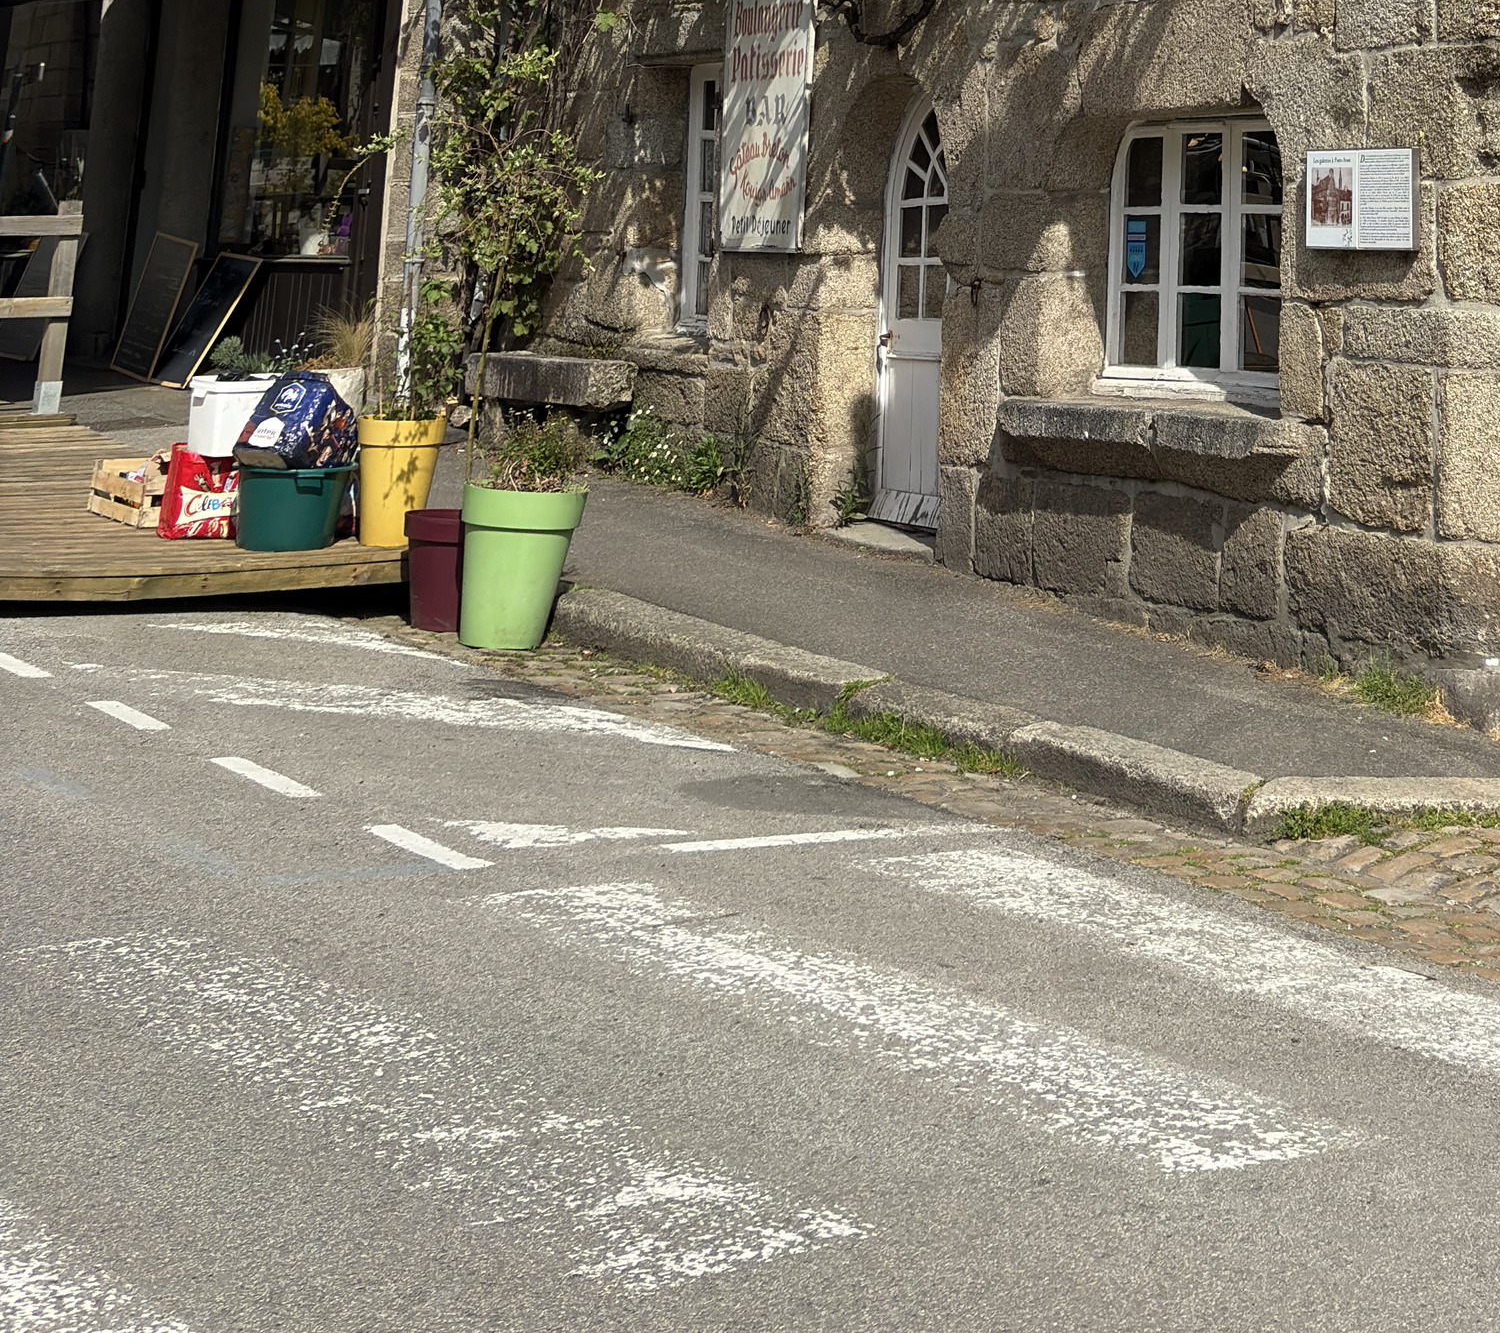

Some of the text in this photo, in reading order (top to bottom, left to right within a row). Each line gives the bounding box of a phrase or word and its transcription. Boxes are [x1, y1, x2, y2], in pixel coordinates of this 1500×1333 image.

[731, 38, 804, 83] Patisserie
[745, 93, 787, 127] BAR
[761, 131, 790, 170] Breton
[731, 215, 792, 237] Petit Déjeuner
